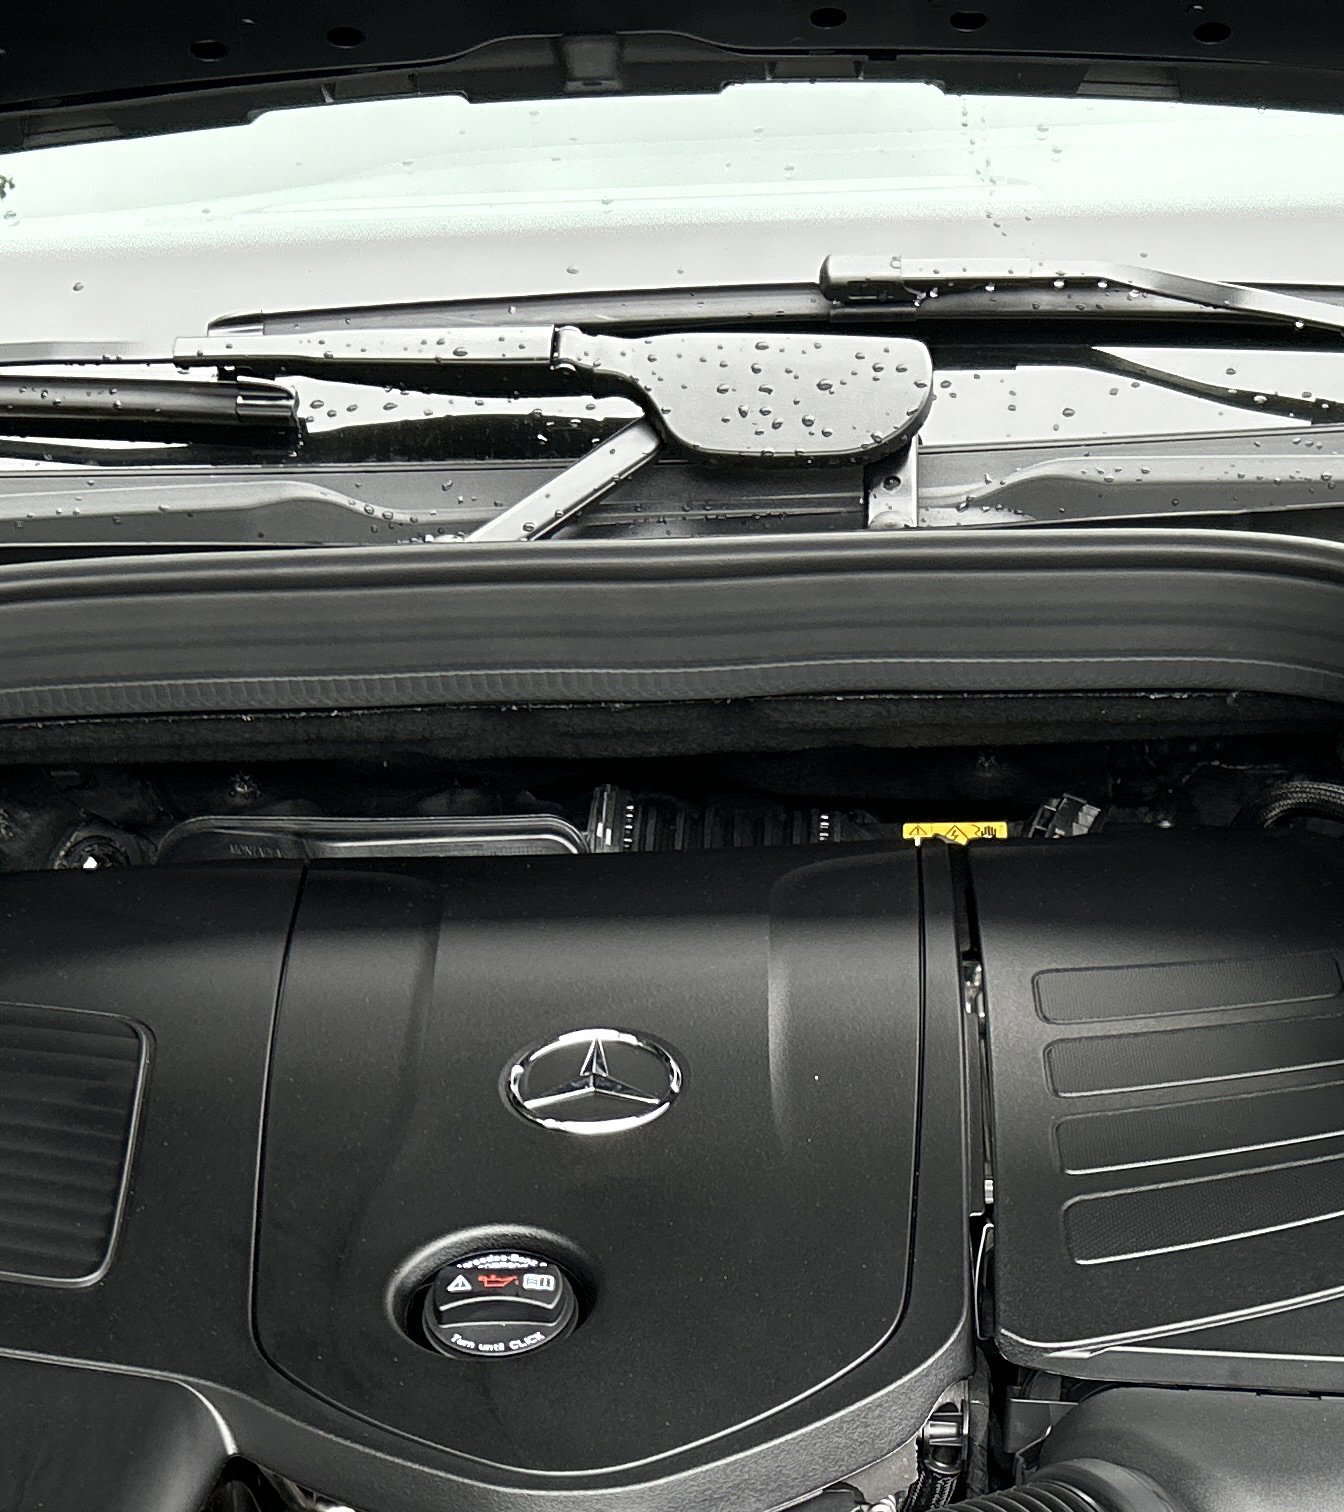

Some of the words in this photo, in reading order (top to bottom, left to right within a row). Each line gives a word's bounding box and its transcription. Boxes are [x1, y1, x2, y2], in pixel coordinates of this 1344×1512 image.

[450, 1332, 476, 1349] Turn
[477, 1342, 505, 1351] until
[508, 1331, 546, 1350] CLICK
